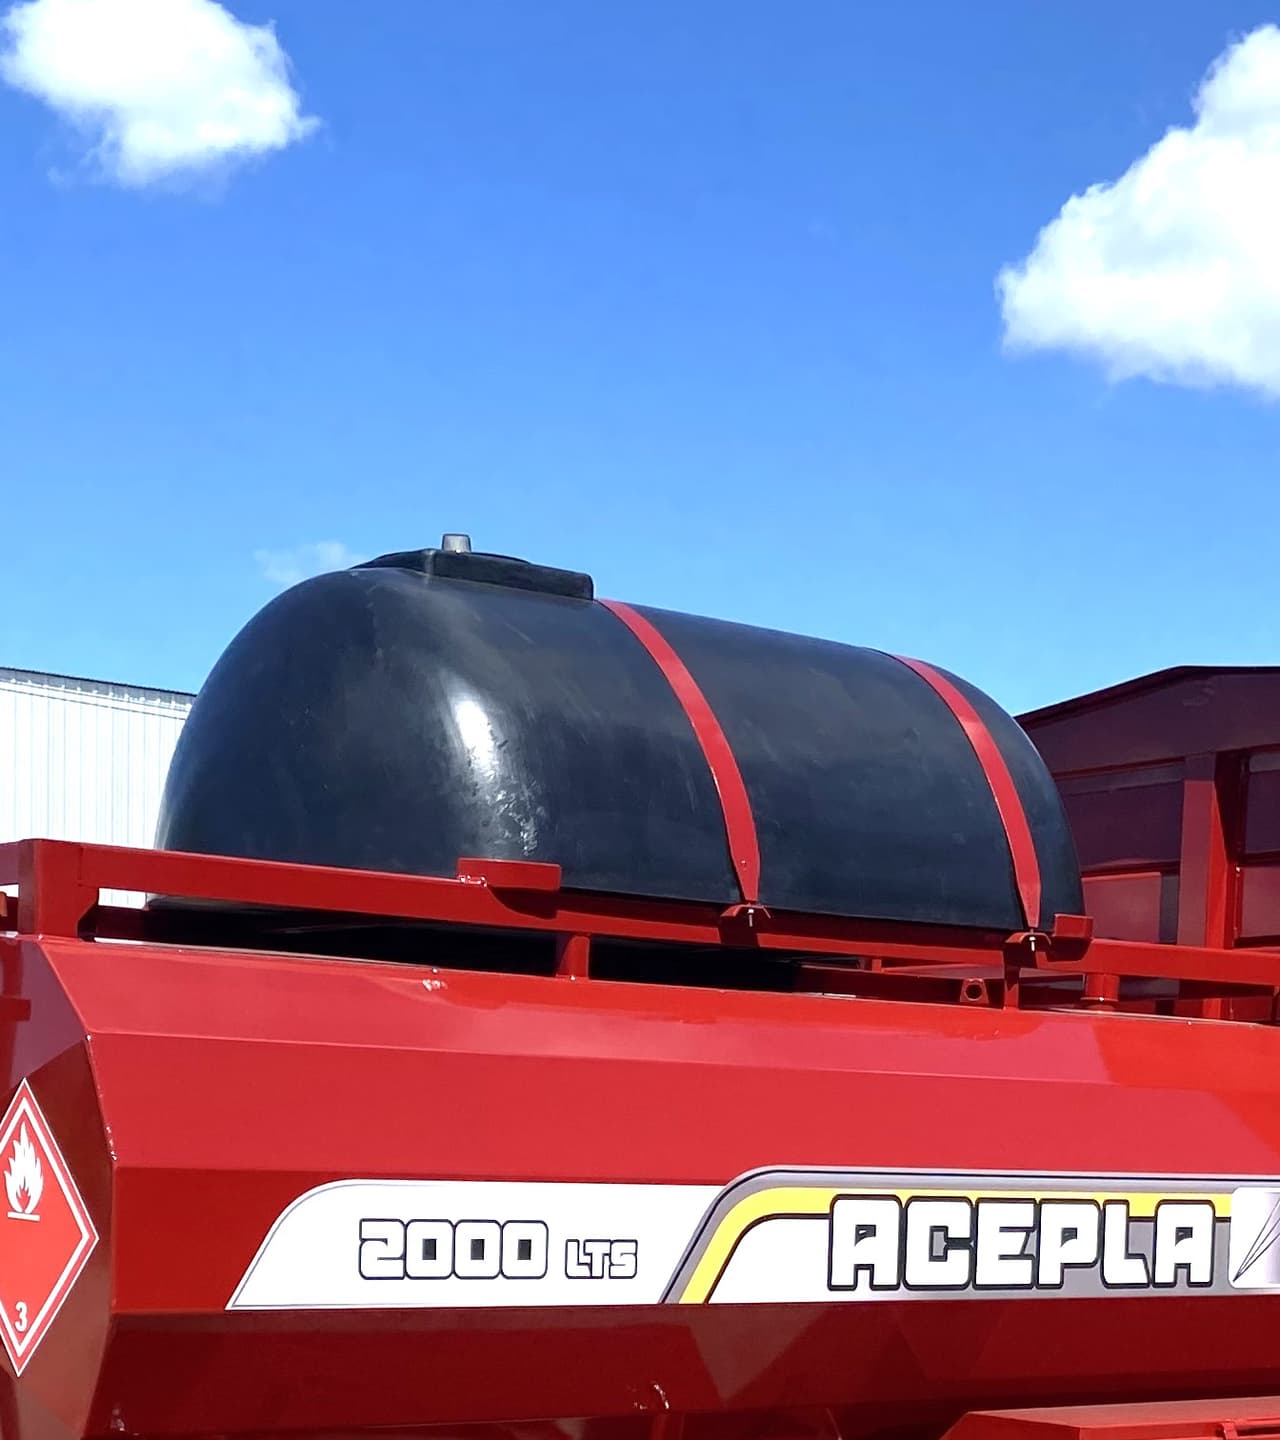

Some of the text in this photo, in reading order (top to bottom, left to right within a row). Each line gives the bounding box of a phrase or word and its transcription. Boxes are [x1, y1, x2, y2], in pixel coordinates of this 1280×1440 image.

[358, 1218, 638, 1280] 2000 LTS
[827, 1194, 1216, 1291] ACEPLA
[14, 1300, 28, 1332] 3
